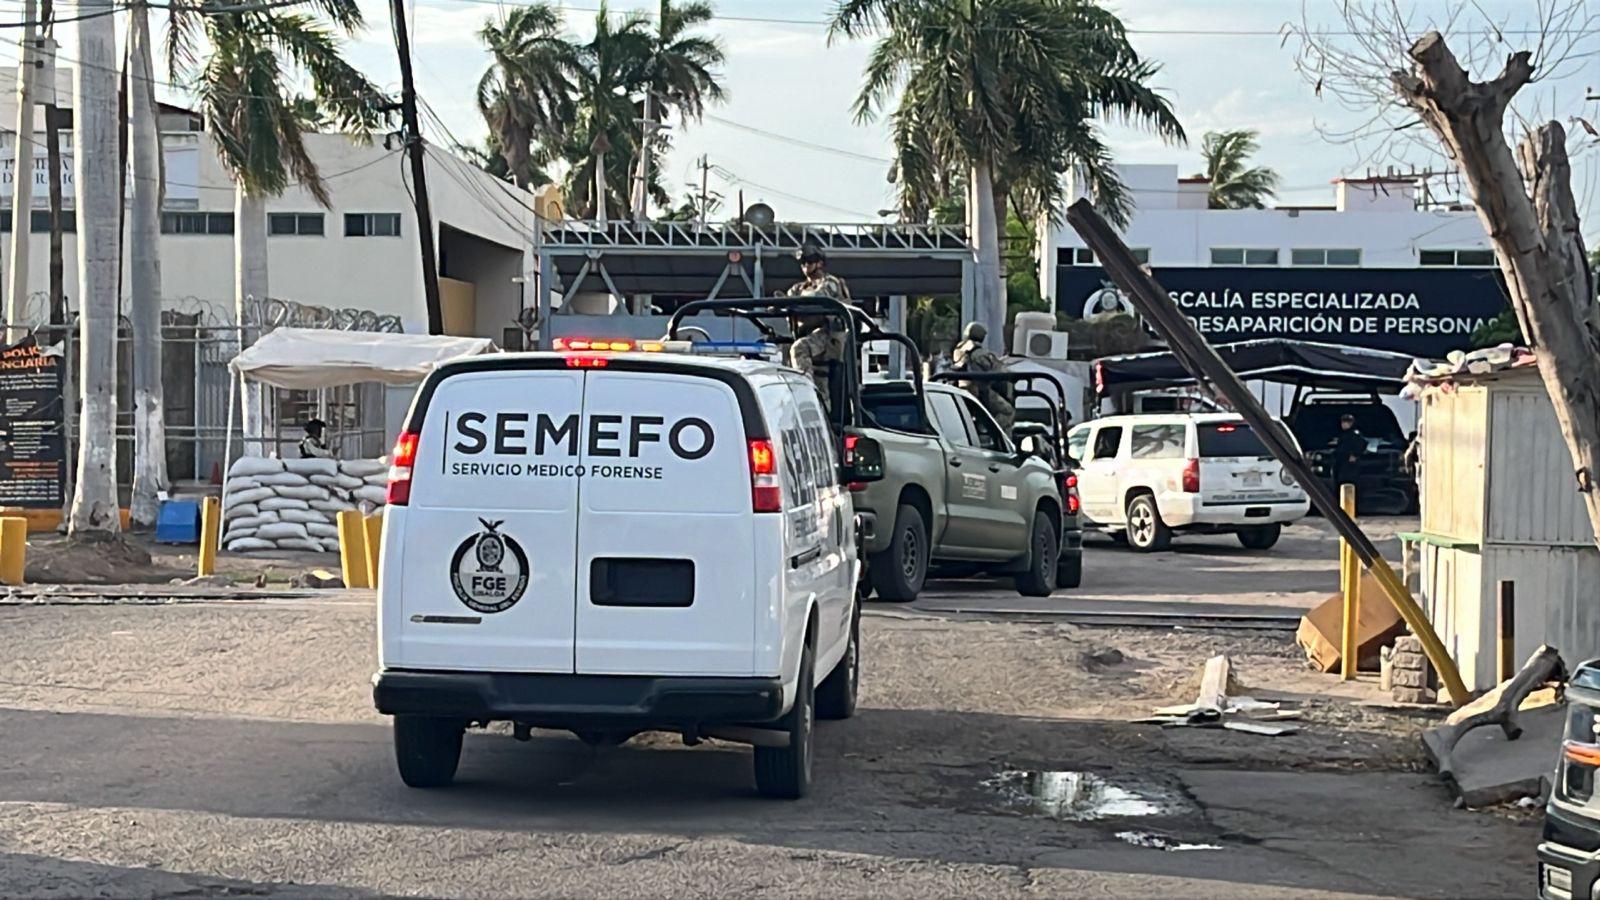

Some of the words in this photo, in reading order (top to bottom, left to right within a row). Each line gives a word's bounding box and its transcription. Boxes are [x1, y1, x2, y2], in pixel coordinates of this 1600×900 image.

[1168, 288, 1244, 308] SCALÍA
[1252, 292, 1420, 309] ESPECIALIZADA
[1349, 317, 1378, 333] DE
[0, 356, 57, 369] NCIARIA
[454, 411, 715, 460] SEMEFO
[452, 463, 522, 476] SERVICIO
[527, 464, 586, 477] MEDICO
[591, 465, 663, 479] FORENSE
[472, 576, 506, 590] FGE
